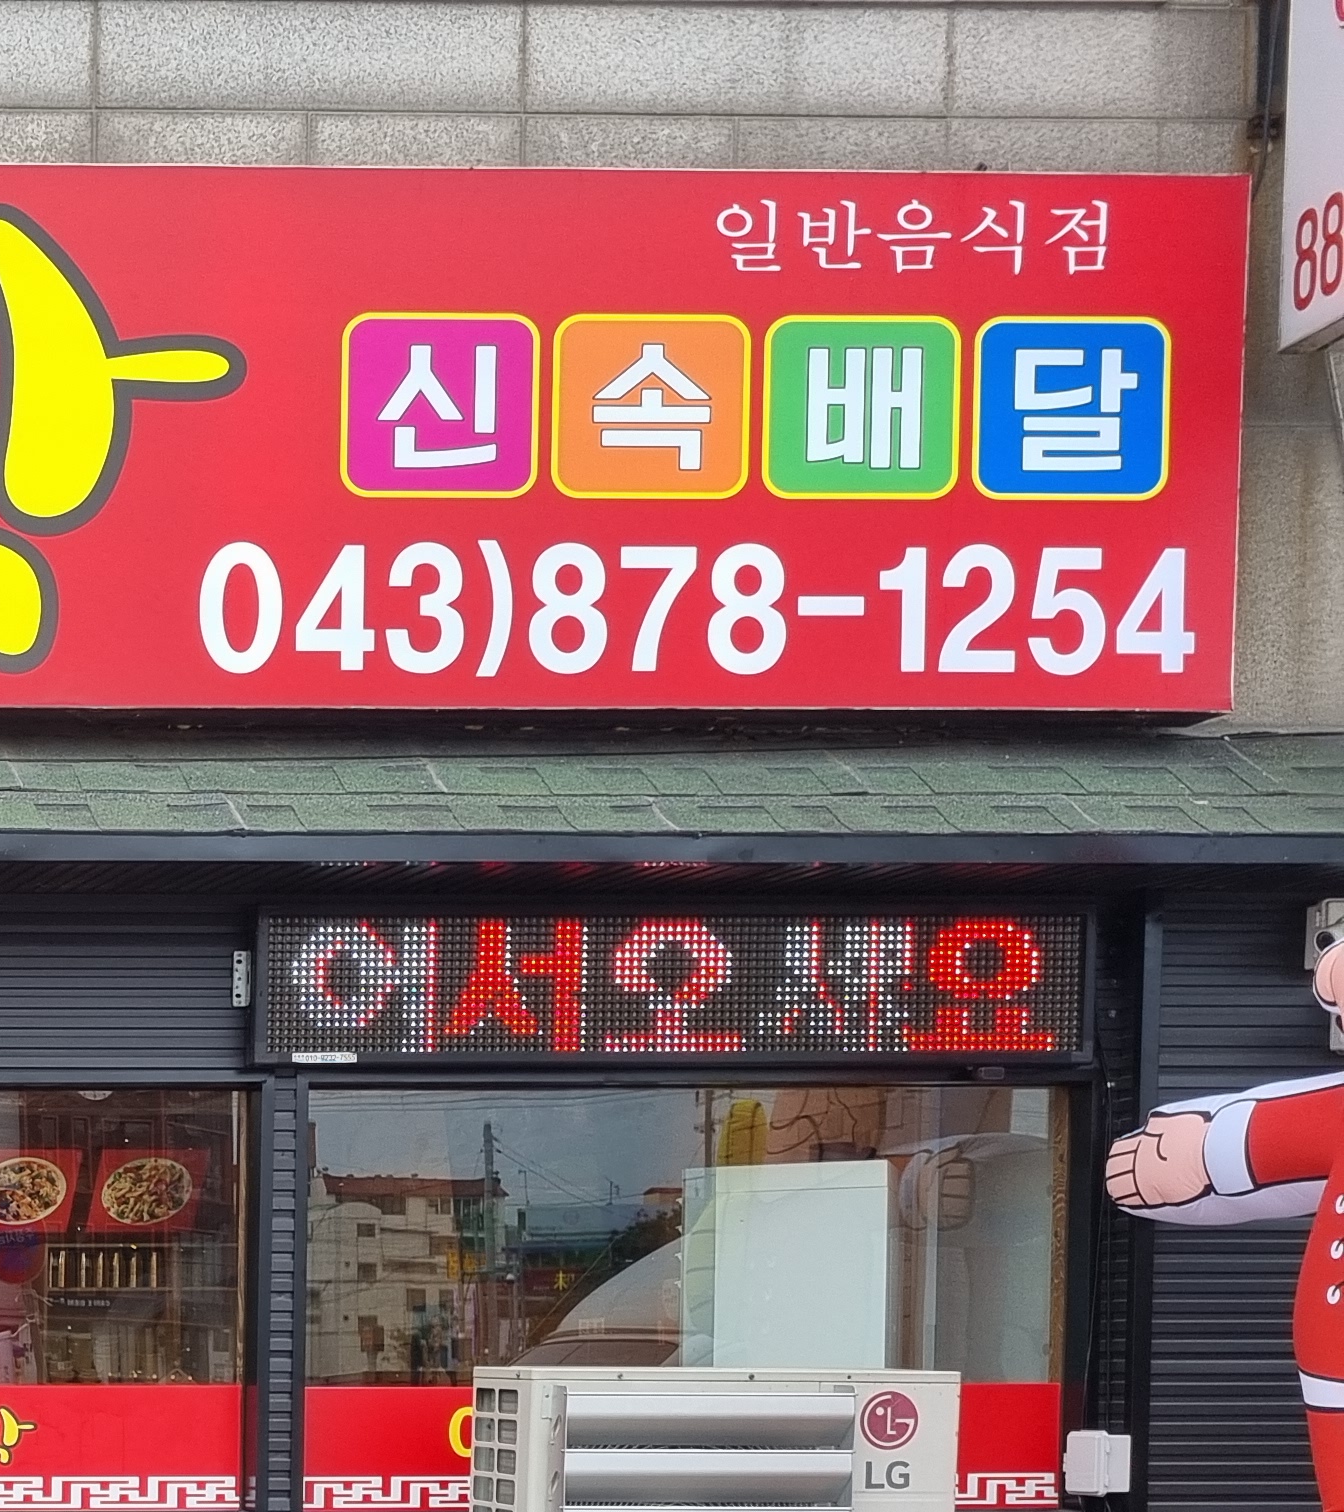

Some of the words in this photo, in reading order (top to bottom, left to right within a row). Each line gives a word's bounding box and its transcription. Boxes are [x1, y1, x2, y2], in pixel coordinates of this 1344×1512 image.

[716, 199, 1111, 275] 일반음식점
[377, 342, 1138, 472] 신속배달
[198, 540, 1197, 678] 043)878-1254
[865, 1461, 910, 1490] LG
